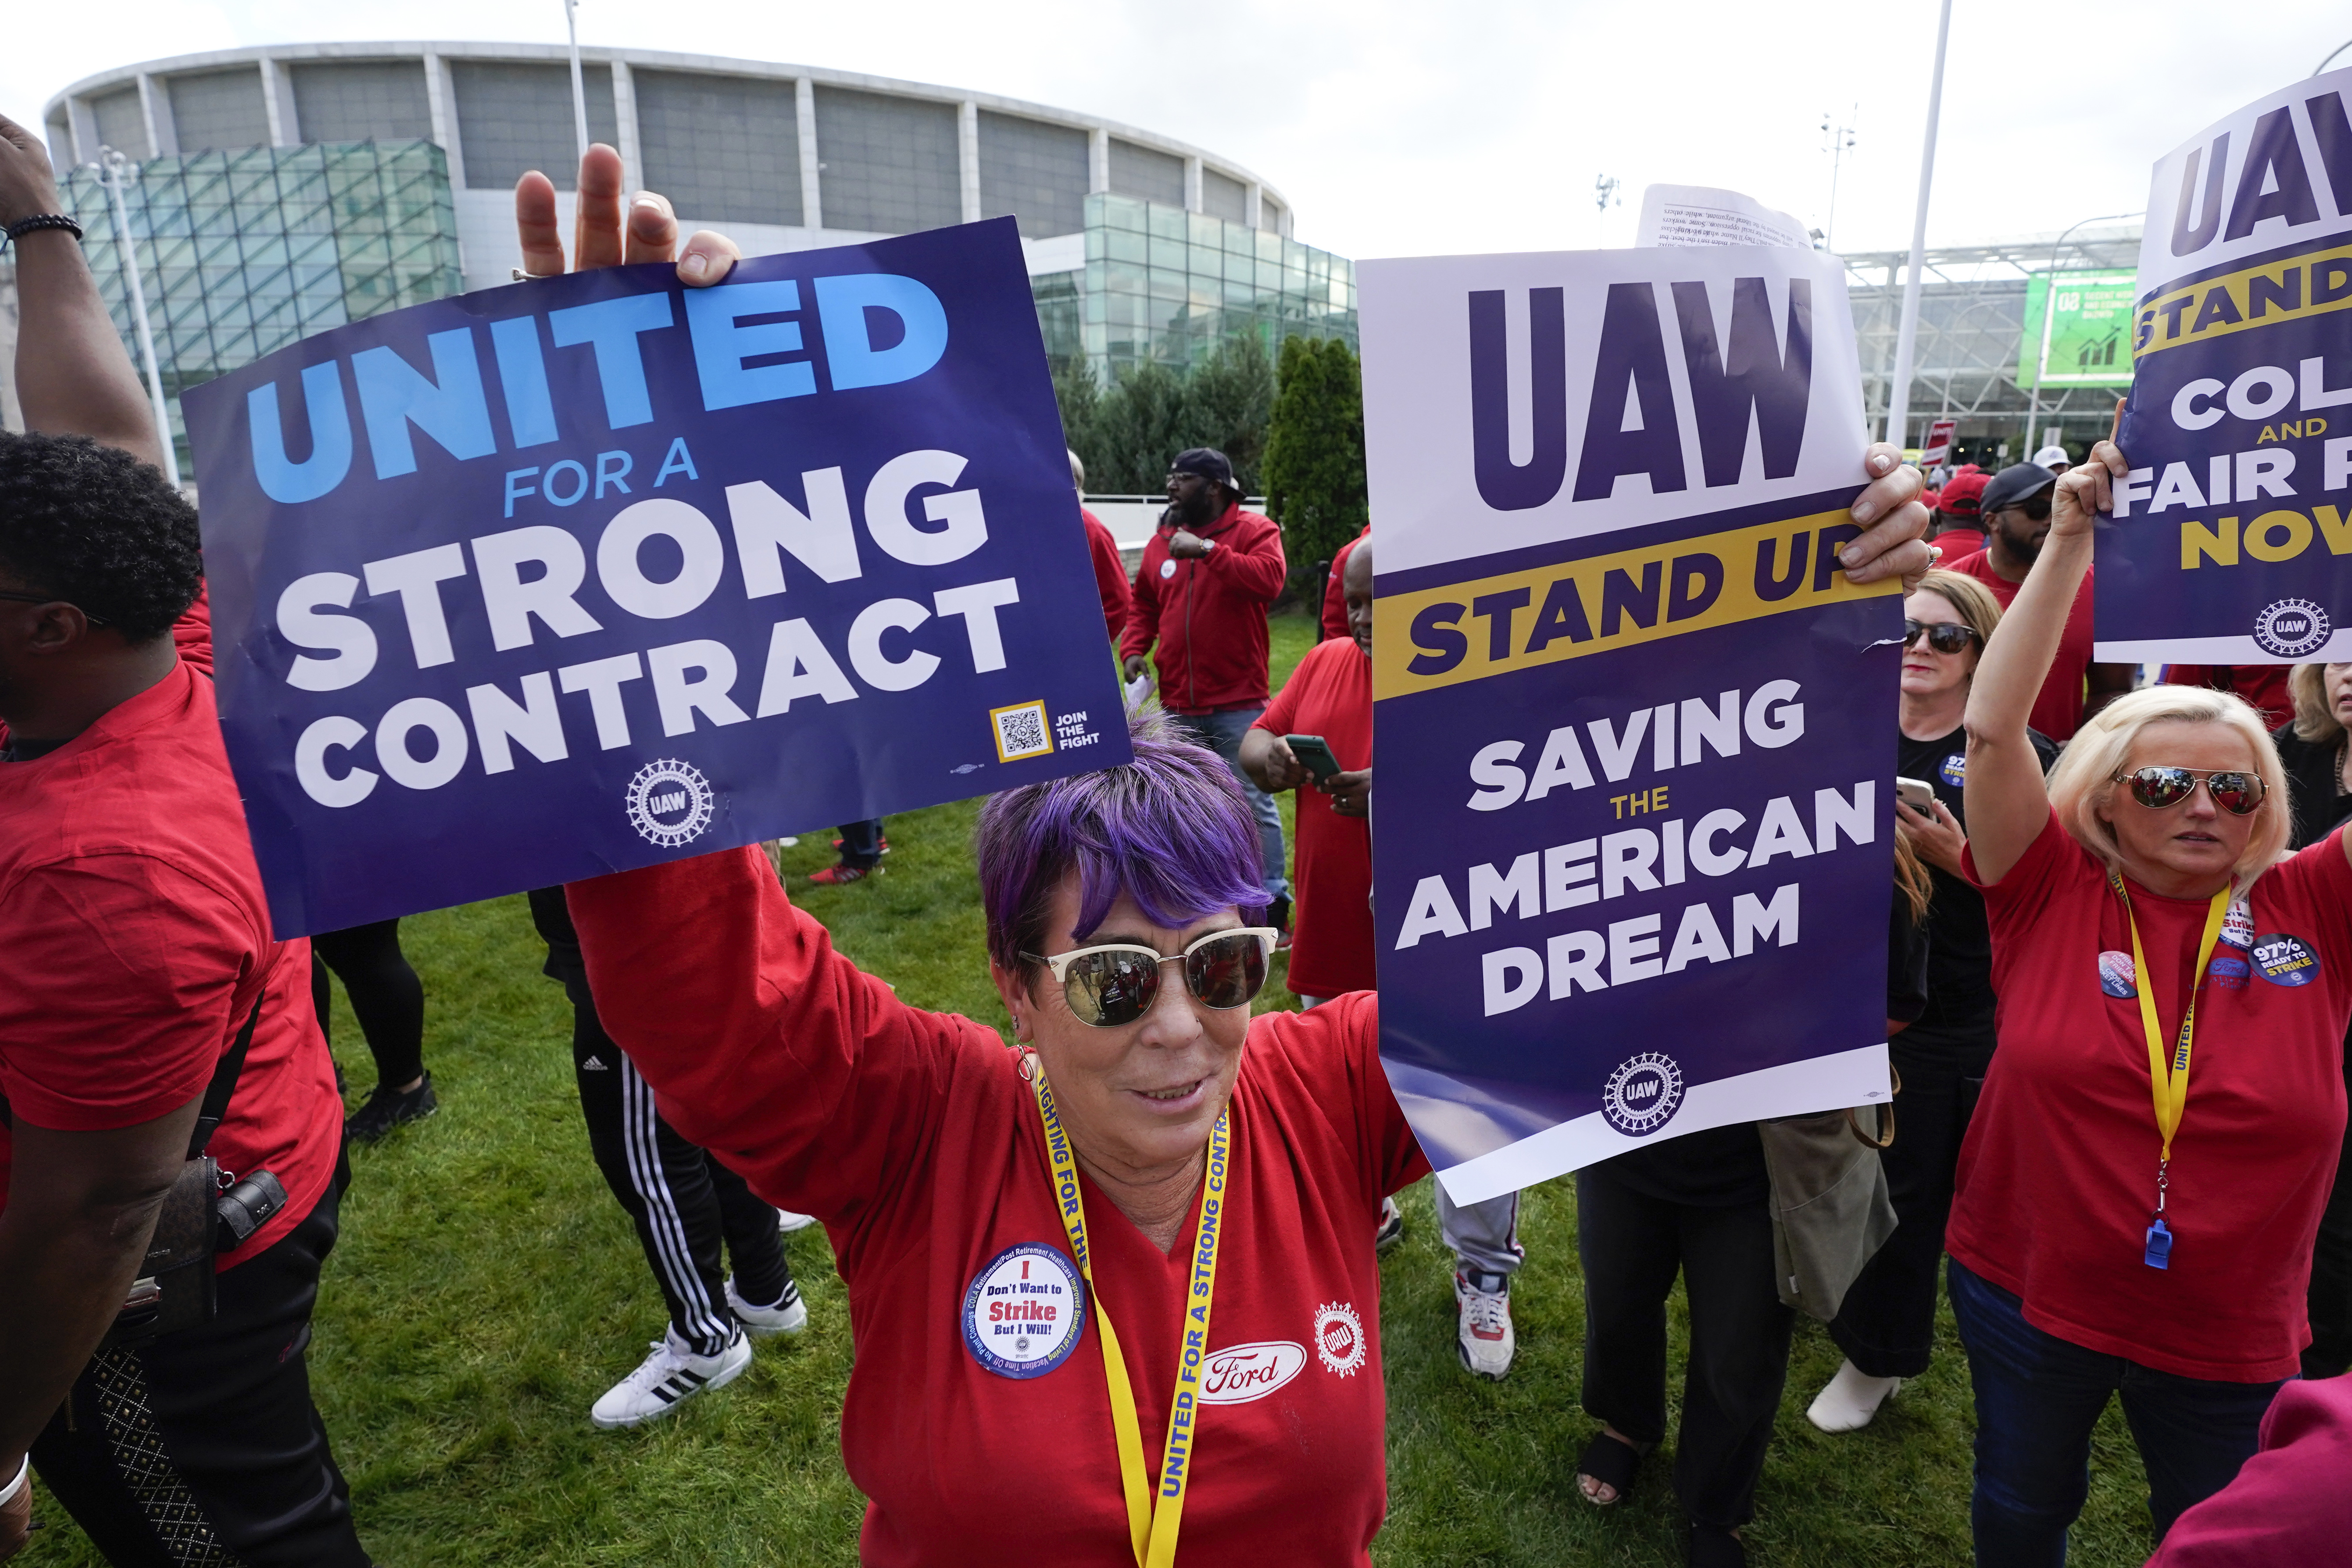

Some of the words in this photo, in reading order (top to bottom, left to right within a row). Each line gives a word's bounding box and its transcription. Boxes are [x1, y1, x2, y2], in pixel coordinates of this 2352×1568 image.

[1706, 213, 1734, 221] argument,
[1709, 222, 1739, 231] oppression.
[1736, 218, 1751, 226] liberal
[1739, 235, 1755, 244] They'll
[2134, 257, 2352, 352] STAND
[247, 273, 949, 504] UNITED
[1468, 276, 1813, 511] UAW
[2171, 356, 2352, 431] COL
[2256, 418, 2327, 444] AND
[504, 449, 633, 518] FOR
[653, 436, 698, 487] A
[2112, 447, 2298, 518] FAIR
[276, 449, 989, 692] STRONG
[1406, 552, 1725, 677] STAND
[1754, 524, 1865, 602] UP
[2277, 620, 2307, 632] UAW
[295, 577, 1020, 808] CONTRACT
[1055, 711, 1087, 726] JOIN
[1057, 724, 1085, 738] THE
[1059, 733, 1100, 750] FIGHT
[1466, 678, 1805, 812] SAVING
[649, 790, 686, 814] UAW
[1609, 786, 1670, 820] THE
[1394, 780, 1876, 951] AMERICAN
[1482, 882, 1799, 1018] DREAM
[2254, 938, 2301, 961] 97%
[2292, 951, 2306, 959] TO
[2109, 960, 2135, 983] FRIENDS
[2111, 954, 2131, 970] DON'T
[2214, 961, 2245, 973] Ford
[2261, 955, 2291, 969] READY
[2266, 957, 2313, 976] STRIKE
[2105, 968, 2124, 985] CROSS
[2111, 980, 2128, 995] LINES
[2175, 1025, 2190, 1070] UNITED
[1626, 1079, 1659, 1100] UAW
[1039, 1076, 1069, 1164] FIGHTING
[1058, 1169, 1079, 1218] FOR
[1070, 1219, 1087, 1271] THE
[1015, 1247, 1048, 1257] Retirement
[1194, 1199, 1219, 1297] STRONG
[975, 1250, 1015, 1290] Retirement/Post
[1022, 1261, 1029, 1279] I
[1048, 1251, 1072, 1278] Healthcare
[968, 1290, 979, 1308] COLA
[987, 1283, 1016, 1296] Don't
[1020, 1282, 1048, 1293] Want
[1051, 1284, 1062, 1294] to
[1069, 1277, 1081, 1308] Improved
[989, 1300, 1056, 1322] Strike
[1190, 1306, 1207, 1323] A
[967, 1311, 977, 1339] Closings
[994, 1325, 1014, 1335] But
[1018, 1324, 1022, 1334] I
[1026, 1324, 1052, 1335] Will!
[1067, 1309, 1082, 1340] Standard
[972, 1337, 986, 1355] Plant
[1063, 1339, 1069, 1348] of
[1324, 1325, 1352, 1352] UAW
[984, 1350, 993, 1362] No
[993, 1357, 1004, 1368] Off
[1047, 1344, 1066, 1361] Living
[1181, 1329, 1203, 1383] FOR
[1004, 1361, 1019, 1372] Time
[1022, 1357, 1049, 1371] Vacation
[1205, 1353, 1279, 1394] Ford
[1162, 1391, 1193, 1498] UNITED
